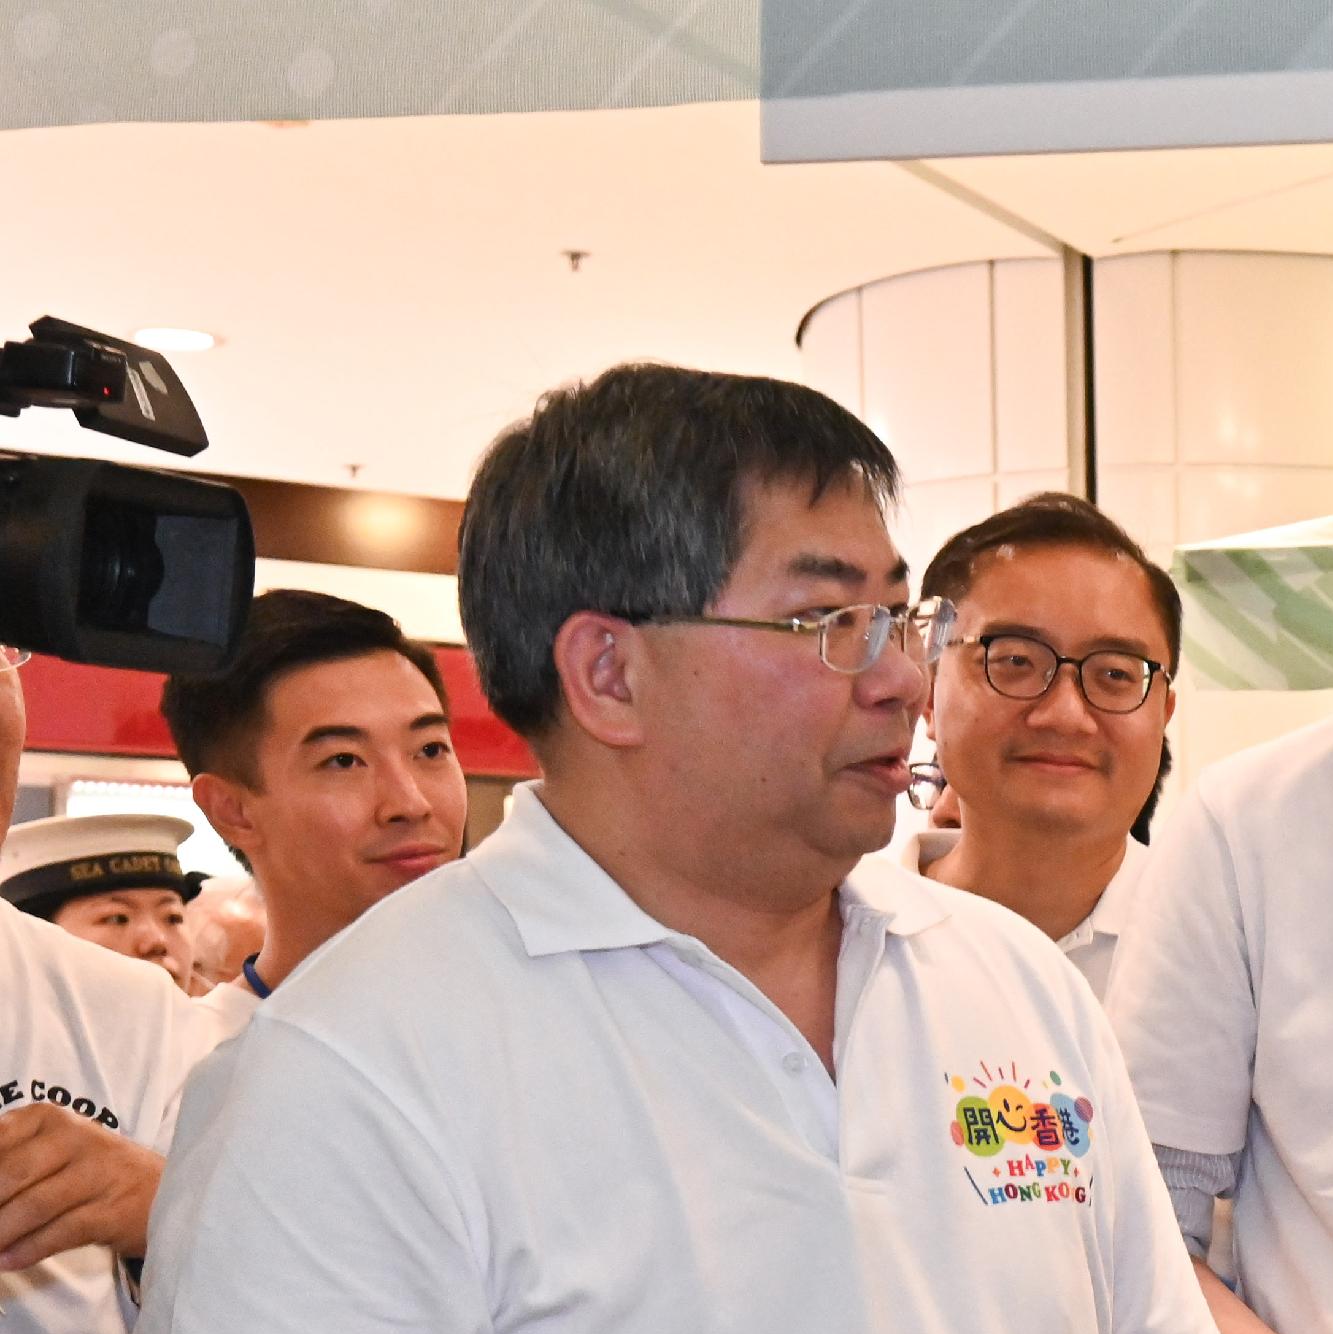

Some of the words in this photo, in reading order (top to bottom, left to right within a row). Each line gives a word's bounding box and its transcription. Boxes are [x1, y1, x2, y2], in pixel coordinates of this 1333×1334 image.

[1007, 1153, 1072, 1177] HAPPY
[988, 1182, 1042, 1205] HONG
[1044, 1181, 1086, 1204] KOG
